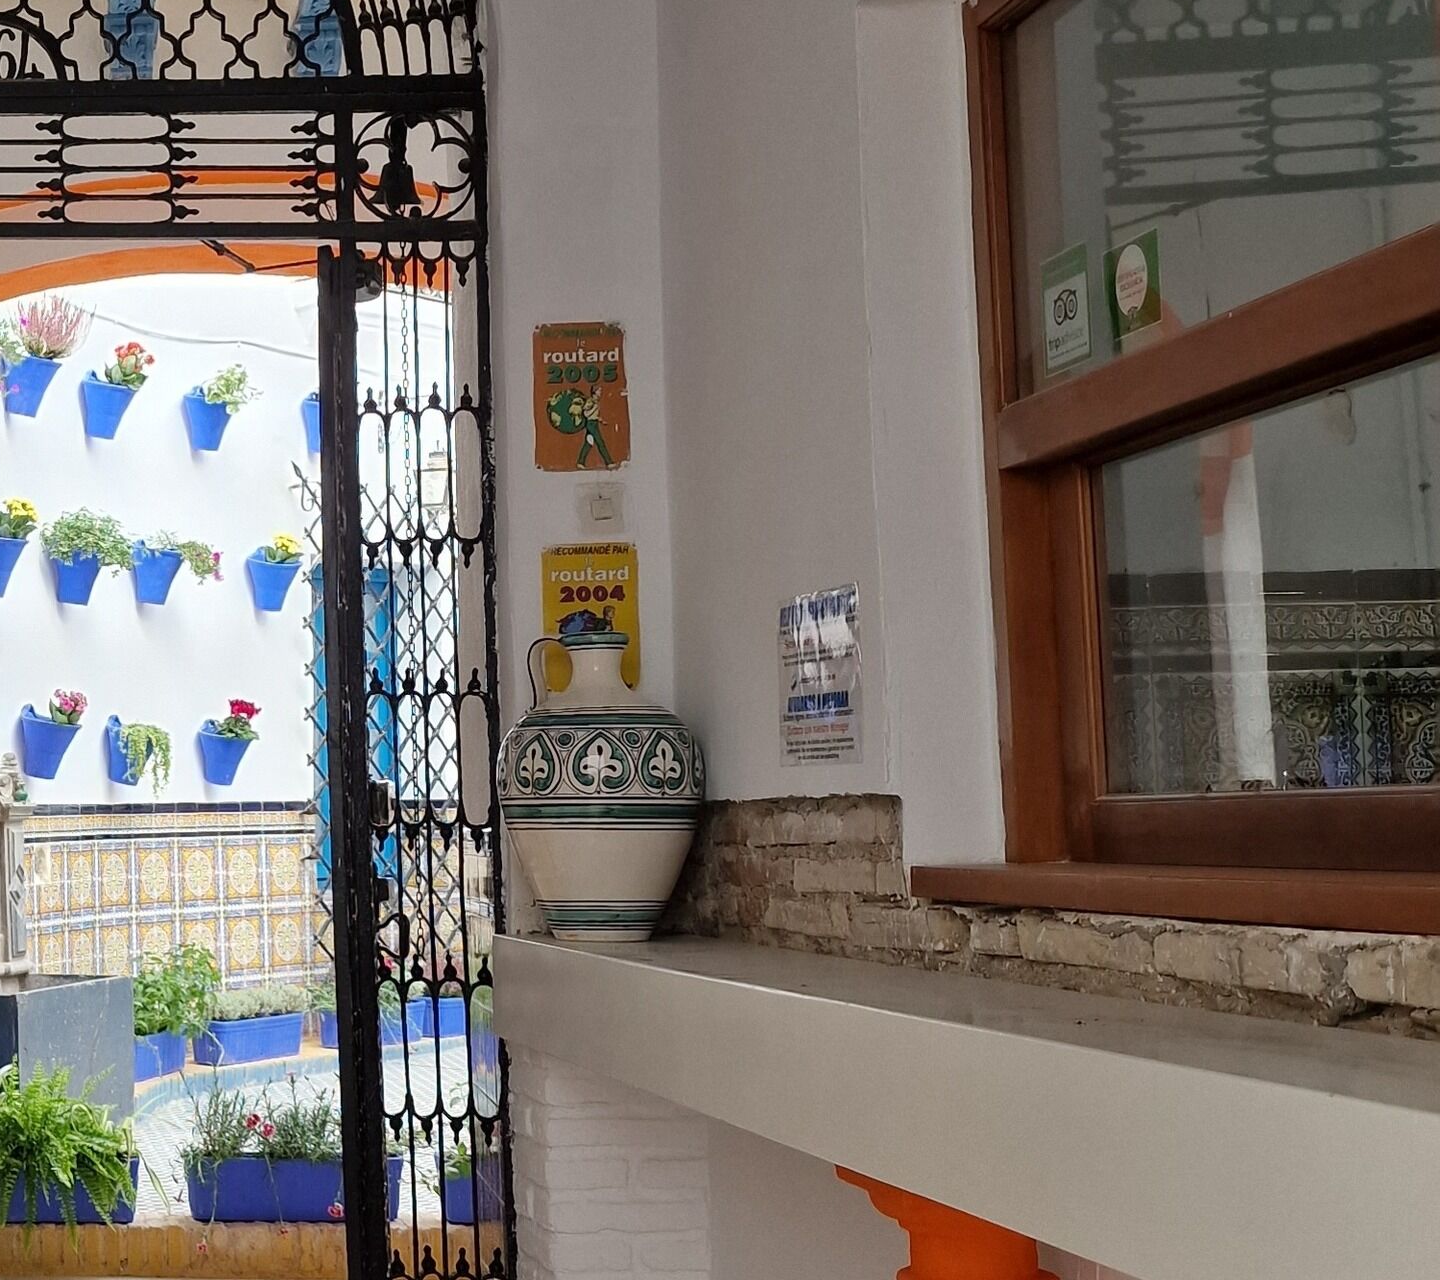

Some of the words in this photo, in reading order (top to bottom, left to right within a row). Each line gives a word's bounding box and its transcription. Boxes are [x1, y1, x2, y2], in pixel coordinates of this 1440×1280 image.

[543, 347, 619, 364] routard
[546, 364, 618, 385] 2005
[551, 565, 629, 582] routard
[559, 585, 626, 603] 2004
